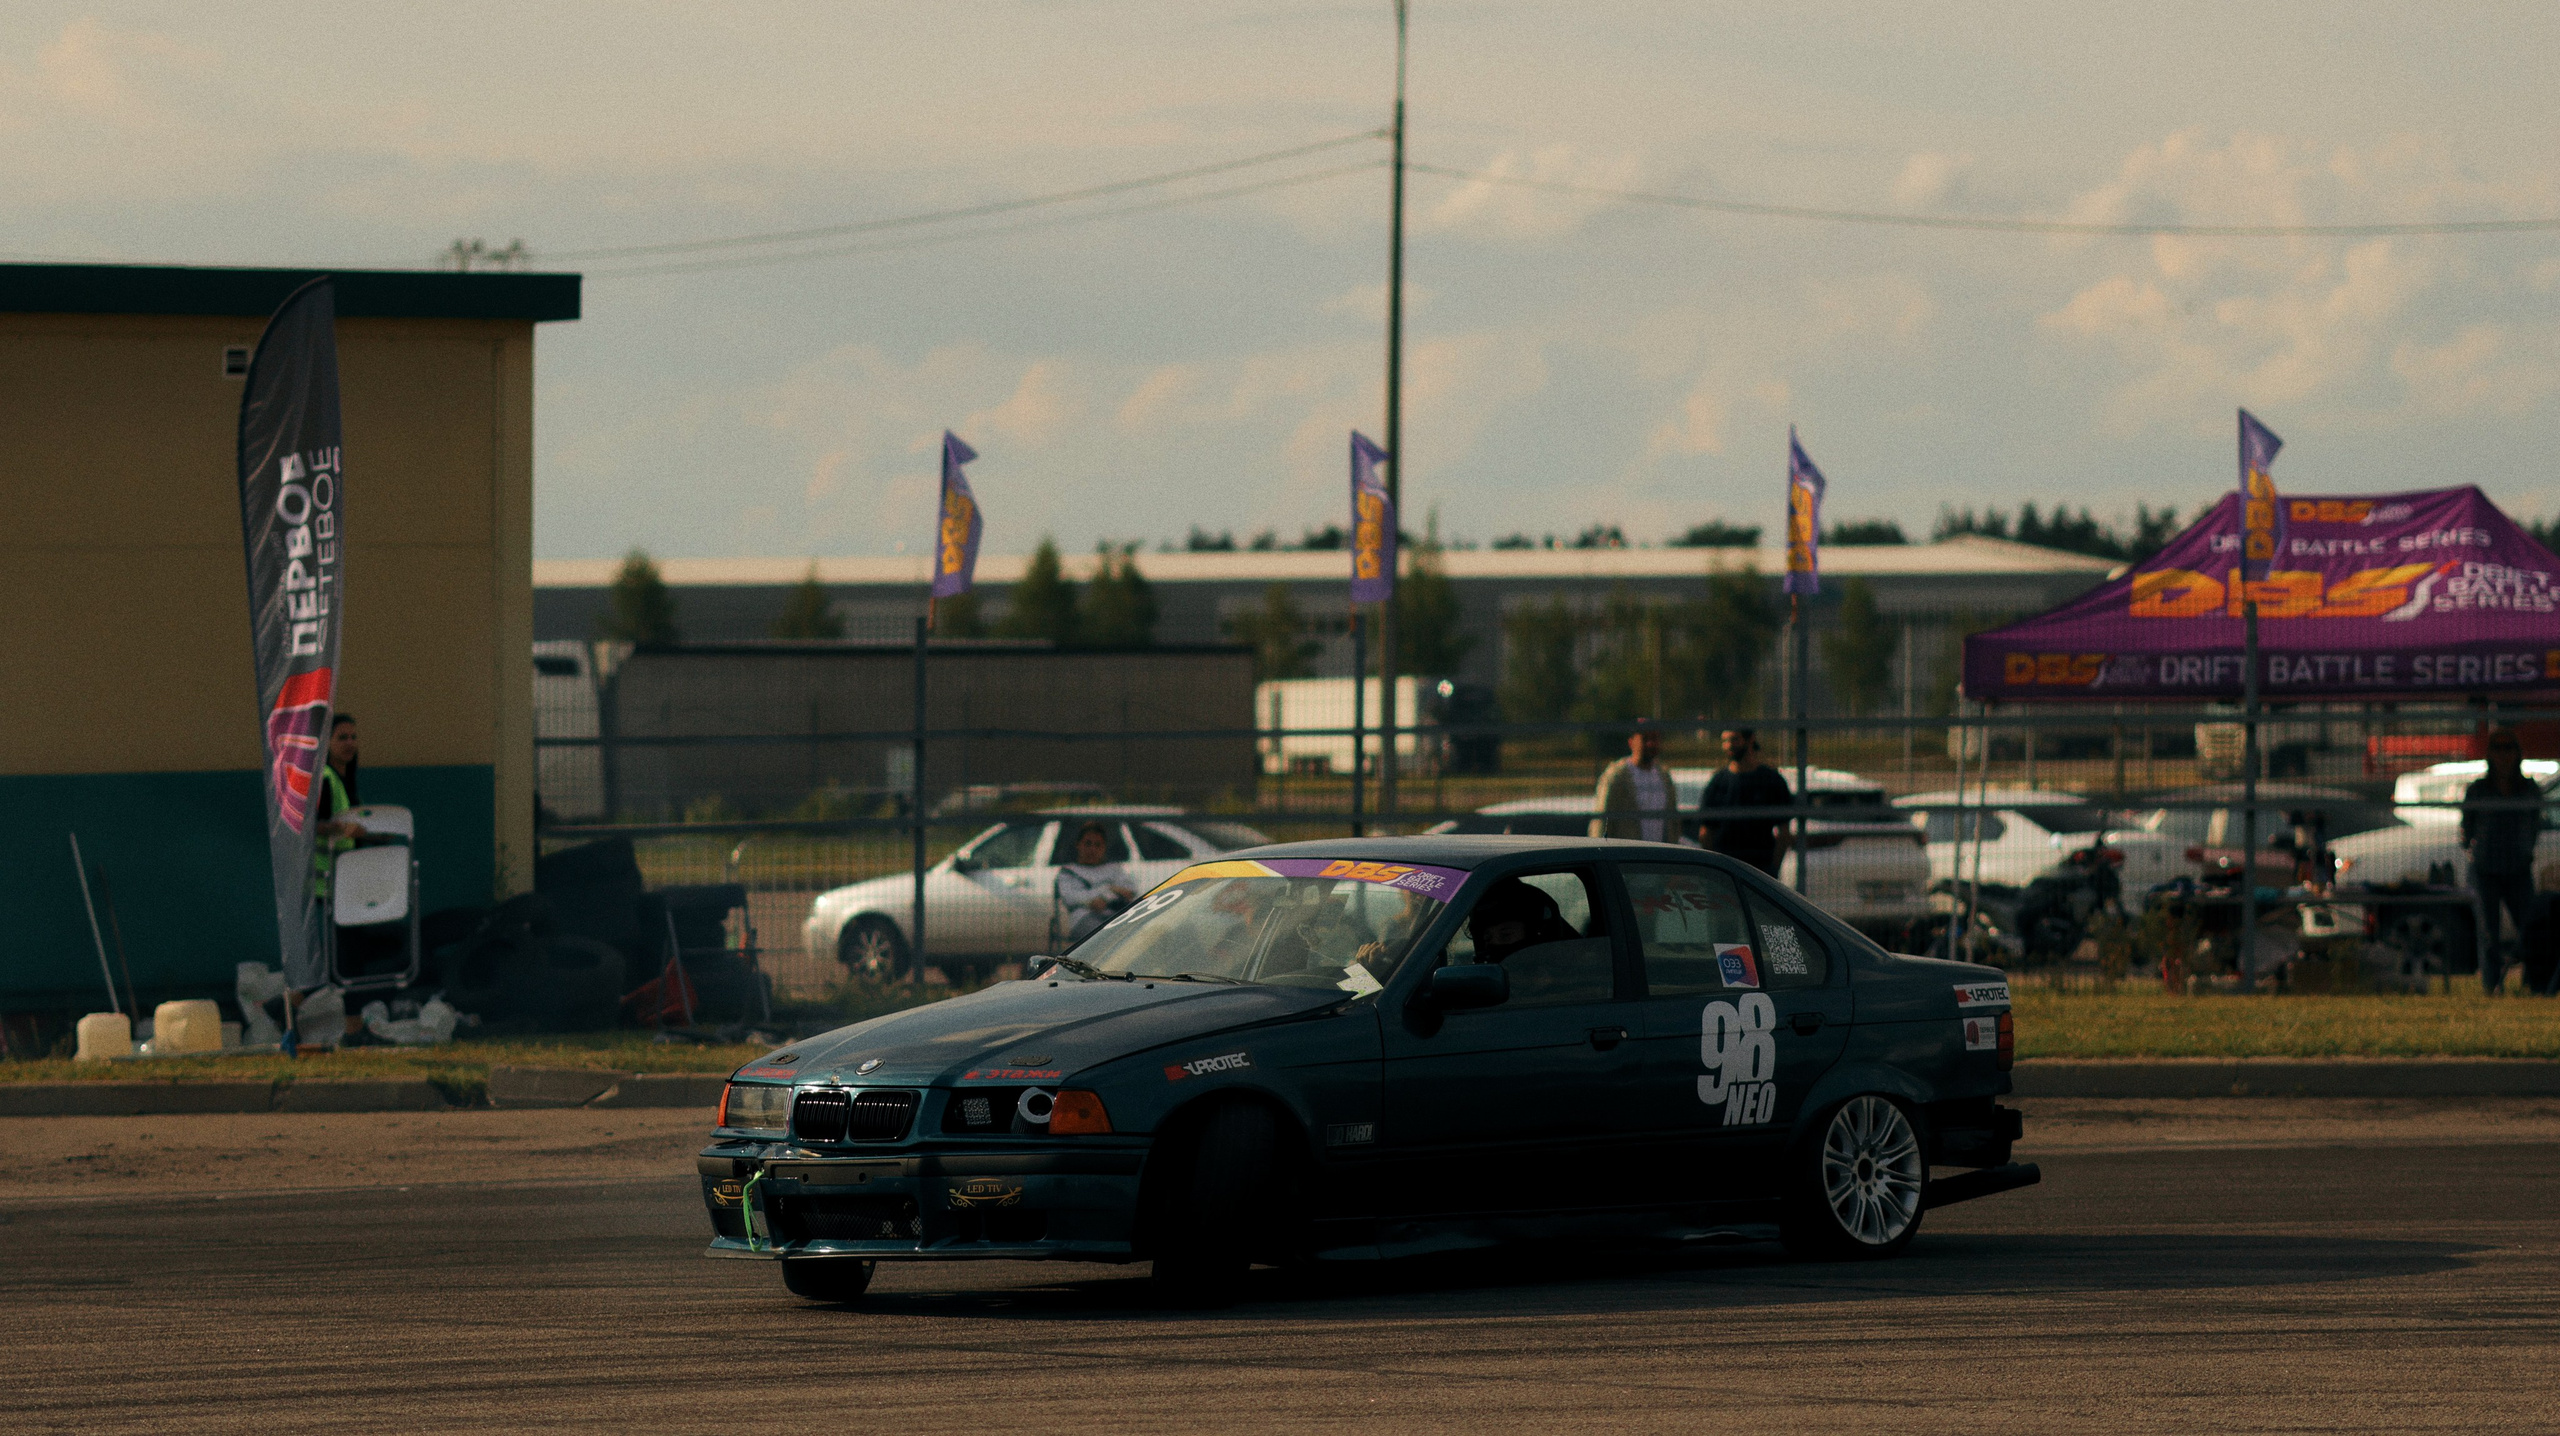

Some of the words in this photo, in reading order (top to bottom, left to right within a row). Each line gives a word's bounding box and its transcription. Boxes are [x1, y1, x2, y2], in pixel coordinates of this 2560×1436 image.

[2290, 500, 2374, 523] DBS
[2291, 536, 2387, 556] BATTLE
[2399, 527, 2492, 552] SERIES
[2130, 567, 2434, 618] DBS
[2004, 654, 2106, 685] DBS
[2159, 655, 2246, 686] DRIFT
[2268, 655, 2396, 685] BATTLE
[2412, 652, 2539, 685] SERIES
[1318, 859, 1416, 883] DBS
[1407, 875, 1444, 889] BATTLE
[1418, 872, 1446, 882] DRIFT
[1396, 880, 1432, 892] SERIES
[1697, 992, 1777, 1105] 98
[1722, 1082, 1777, 1126] NEO
[967, 1184, 985, 1194] LED
